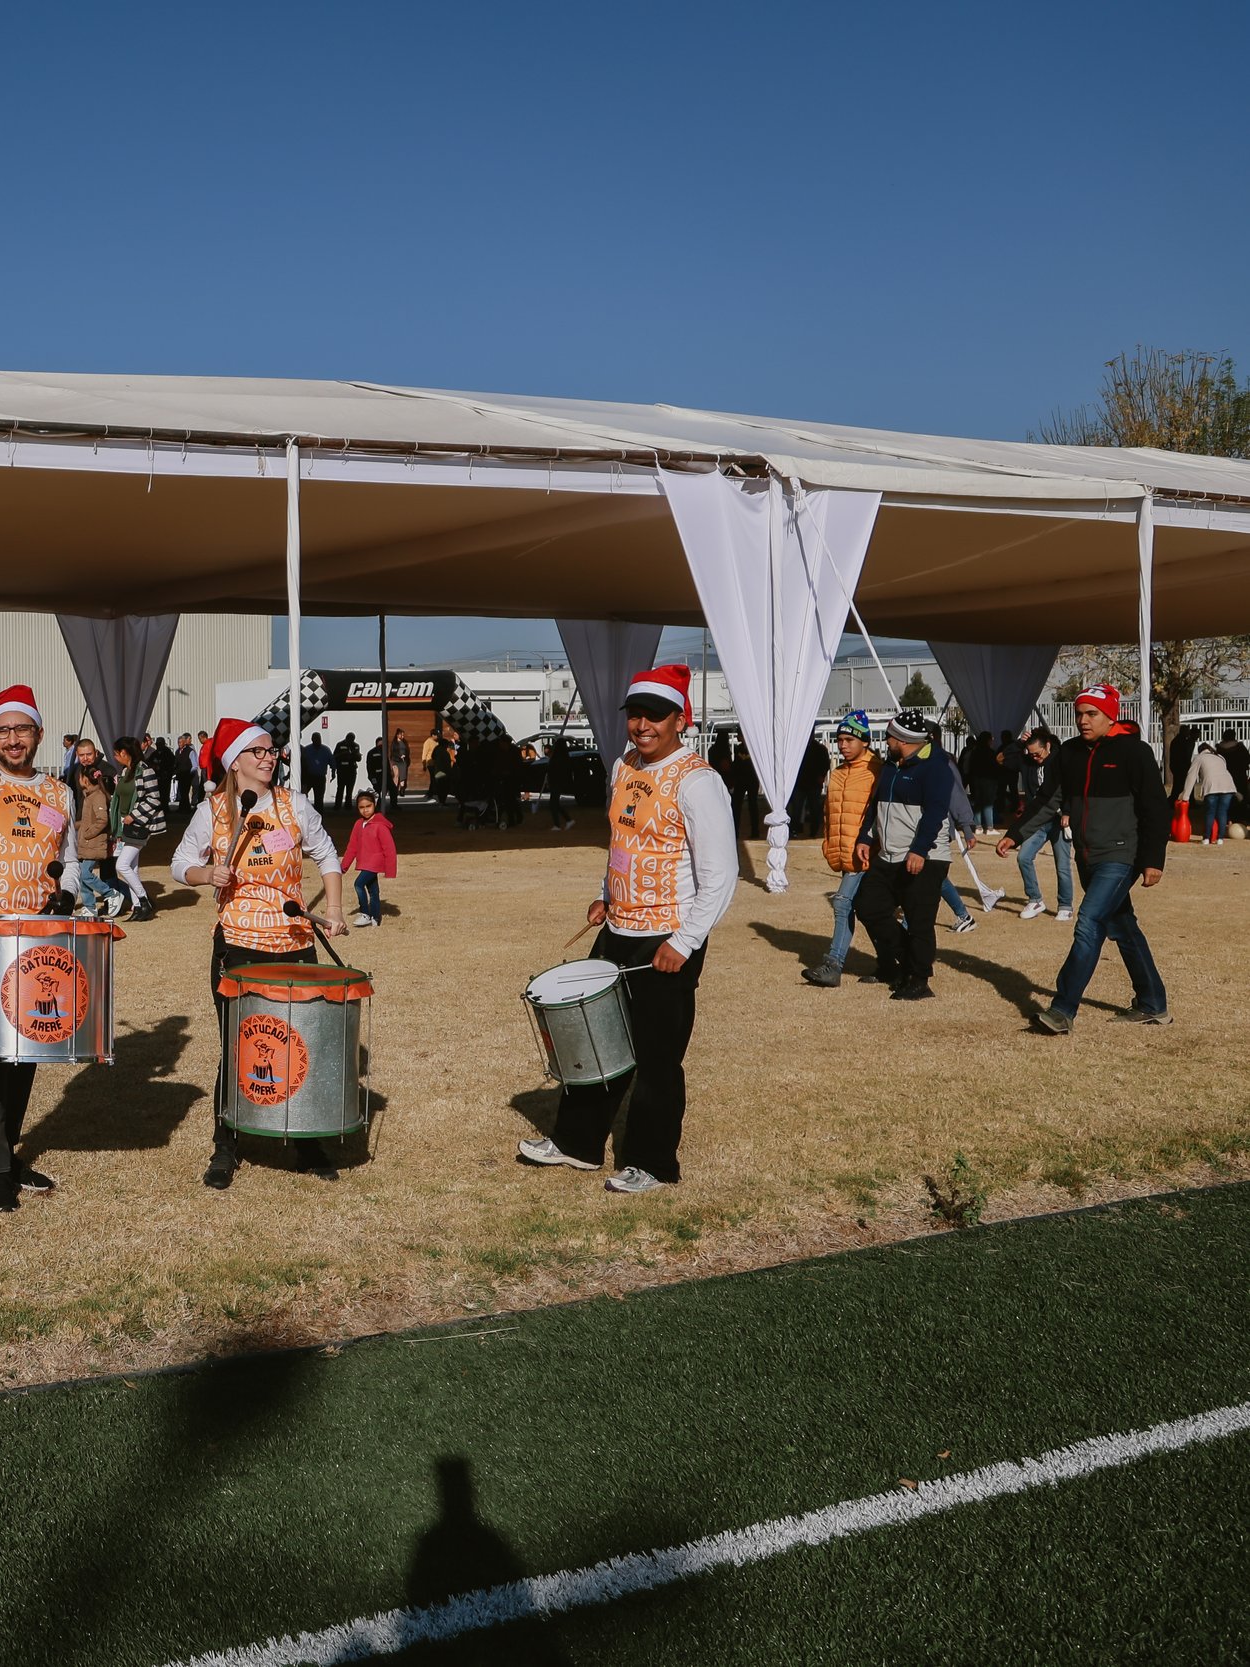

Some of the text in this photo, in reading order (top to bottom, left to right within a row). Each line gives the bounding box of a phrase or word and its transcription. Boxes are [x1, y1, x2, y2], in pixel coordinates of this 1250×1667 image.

[347, 682, 434, 698] can-am
[625, 781, 653, 797] BATUCADA
[3, 794, 41, 809] BATUCADA
[11, 828, 36, 838] ARERÉ
[247, 854, 274, 867] ARERÉ
[20, 956, 73, 976] BATUCADA
[30, 1017, 63, 1032] ARERÉ
[243, 1023, 288, 1045] BATUCADA
[249, 1081, 278, 1096] ARERÉ
